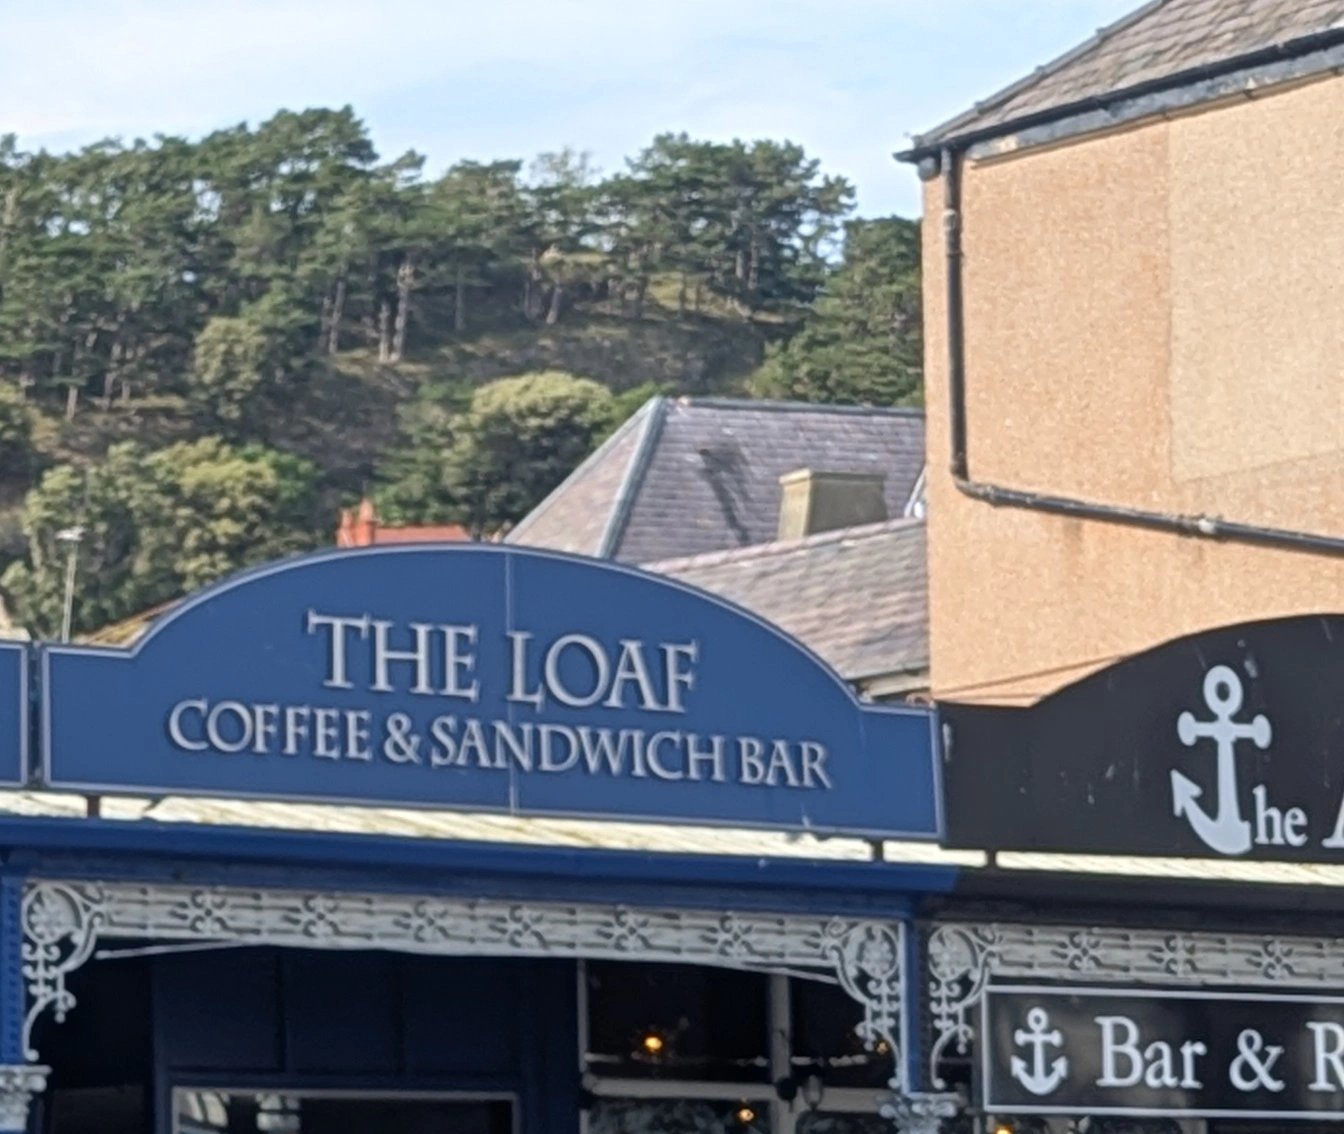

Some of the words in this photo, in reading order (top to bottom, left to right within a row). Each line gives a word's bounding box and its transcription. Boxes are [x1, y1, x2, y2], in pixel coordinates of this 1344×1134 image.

[307, 610, 482, 703] THE
[505, 631, 700, 715] LOAF
[167, 698, 374, 764] COFFEE
[385, 713, 423, 766] &
[431, 720, 725, 784] SANDWICH
[738, 740, 833, 790] BAR
[1094, 1015, 1208, 1089] Bar
[1229, 1028, 1286, 1092] &
